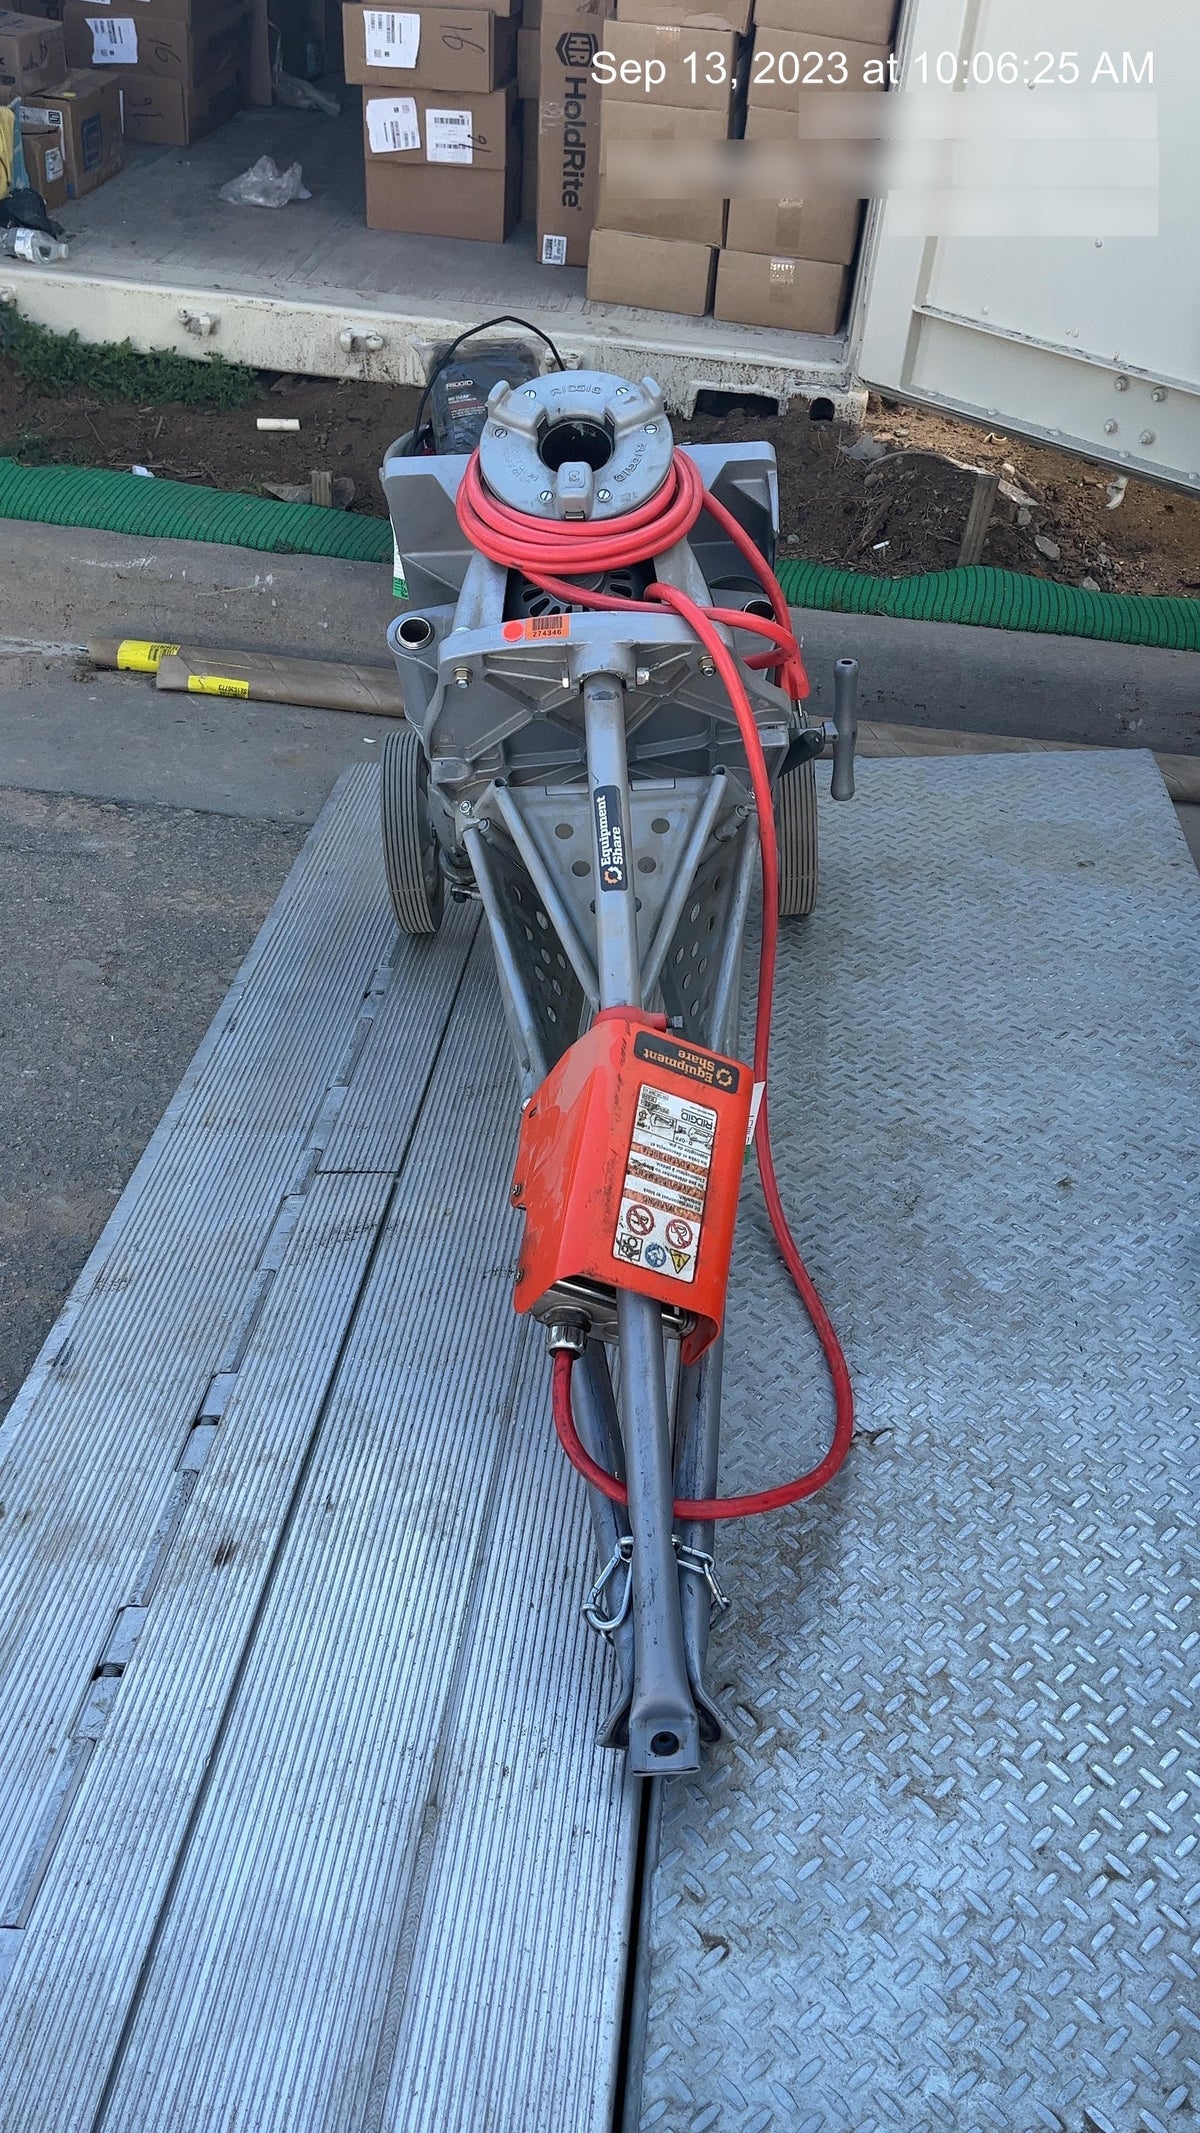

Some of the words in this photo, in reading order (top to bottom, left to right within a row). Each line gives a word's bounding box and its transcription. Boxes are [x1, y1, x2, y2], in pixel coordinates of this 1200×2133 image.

[562, 76, 587, 209] HoldRite
[551, 384, 602, 397] RIDGID
[613, 442, 647, 483] RIDGID
[532, 629, 562, 638] 274346
[596, 794, 613, 867] Equipment
[612, 826, 624, 865] Share
[643, 1048, 714, 1084] Equipment
[678, 1049, 716, 1072] Share
[680, 1112, 713, 1130] RIDGID
